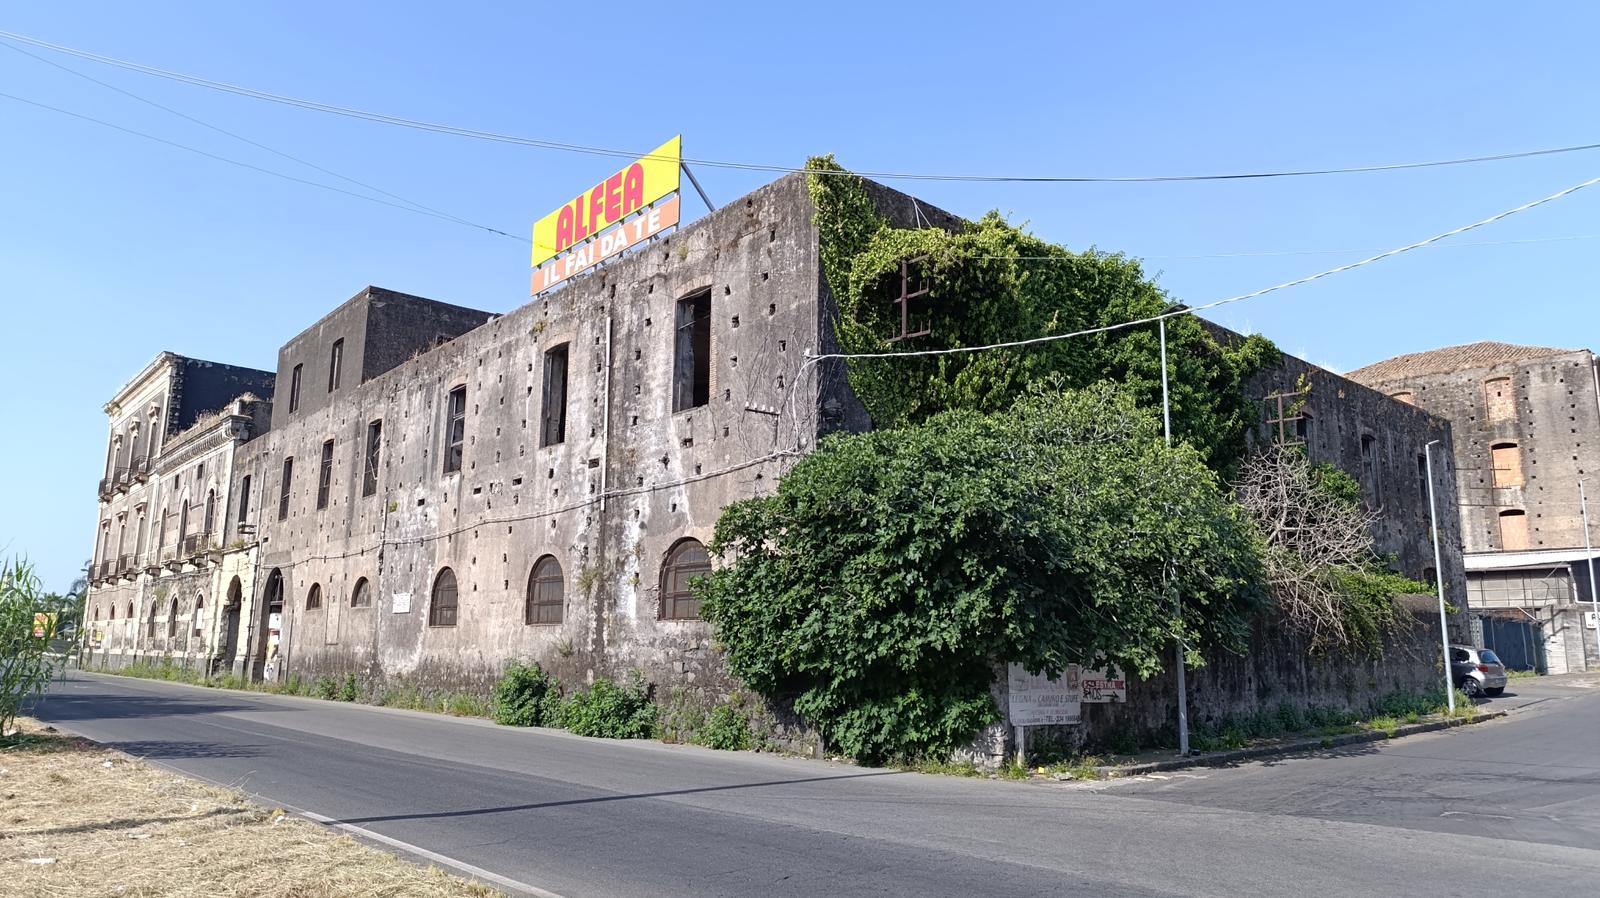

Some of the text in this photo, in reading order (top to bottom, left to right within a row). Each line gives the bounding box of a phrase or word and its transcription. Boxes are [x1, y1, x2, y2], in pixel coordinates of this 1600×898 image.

[543, 208, 661, 287] IL FAI DA TE
[555, 162, 644, 252] ALFEA
